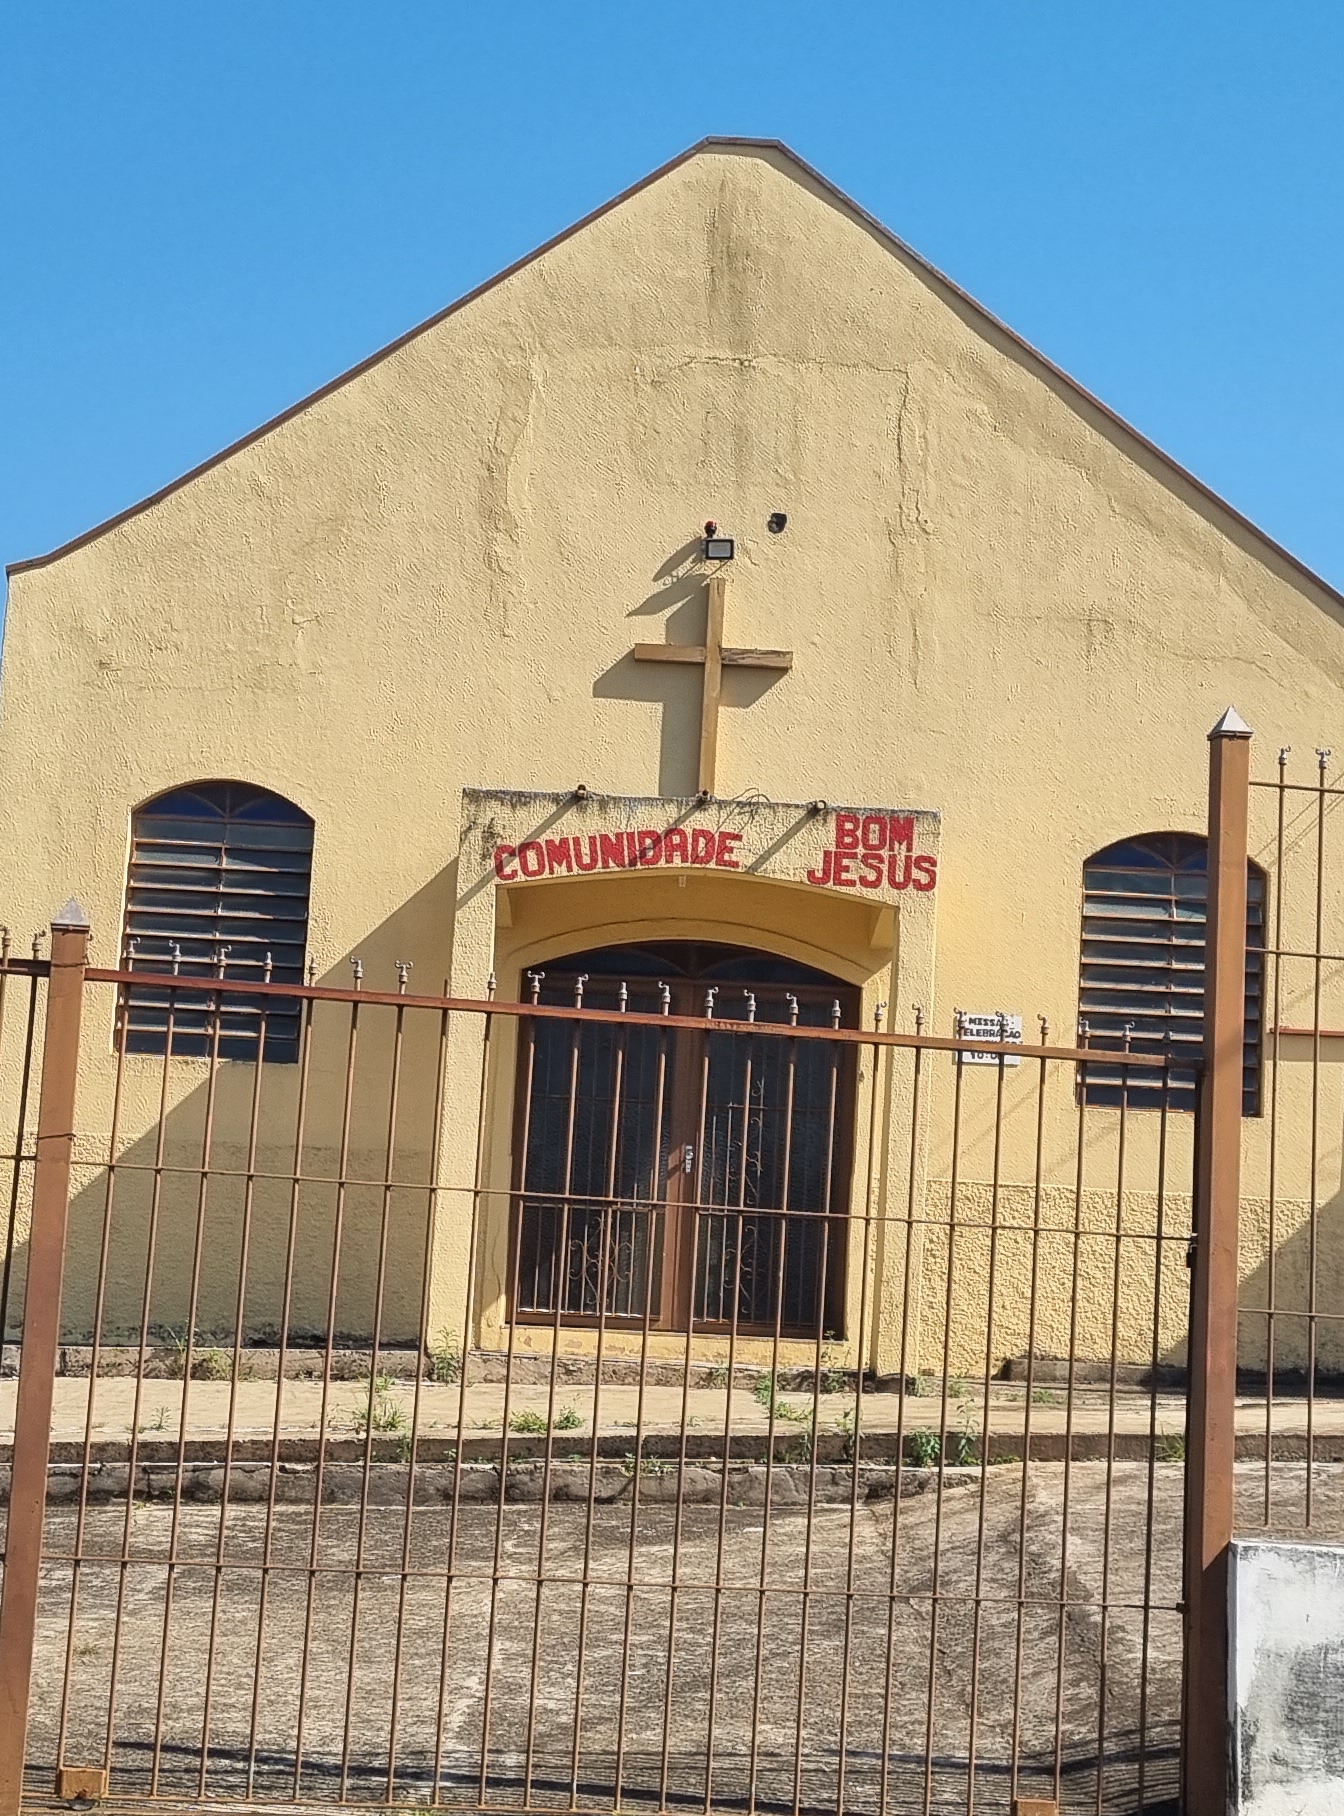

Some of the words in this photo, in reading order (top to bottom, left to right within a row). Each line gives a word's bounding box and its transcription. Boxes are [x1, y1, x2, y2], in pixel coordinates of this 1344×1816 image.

[835, 815, 914, 851] BOM
[494, 828, 743, 881] COMUNIDADE
[807, 850, 938, 892] JESUS
[957, 1027, 1021, 1039] ELEBRAÃO
